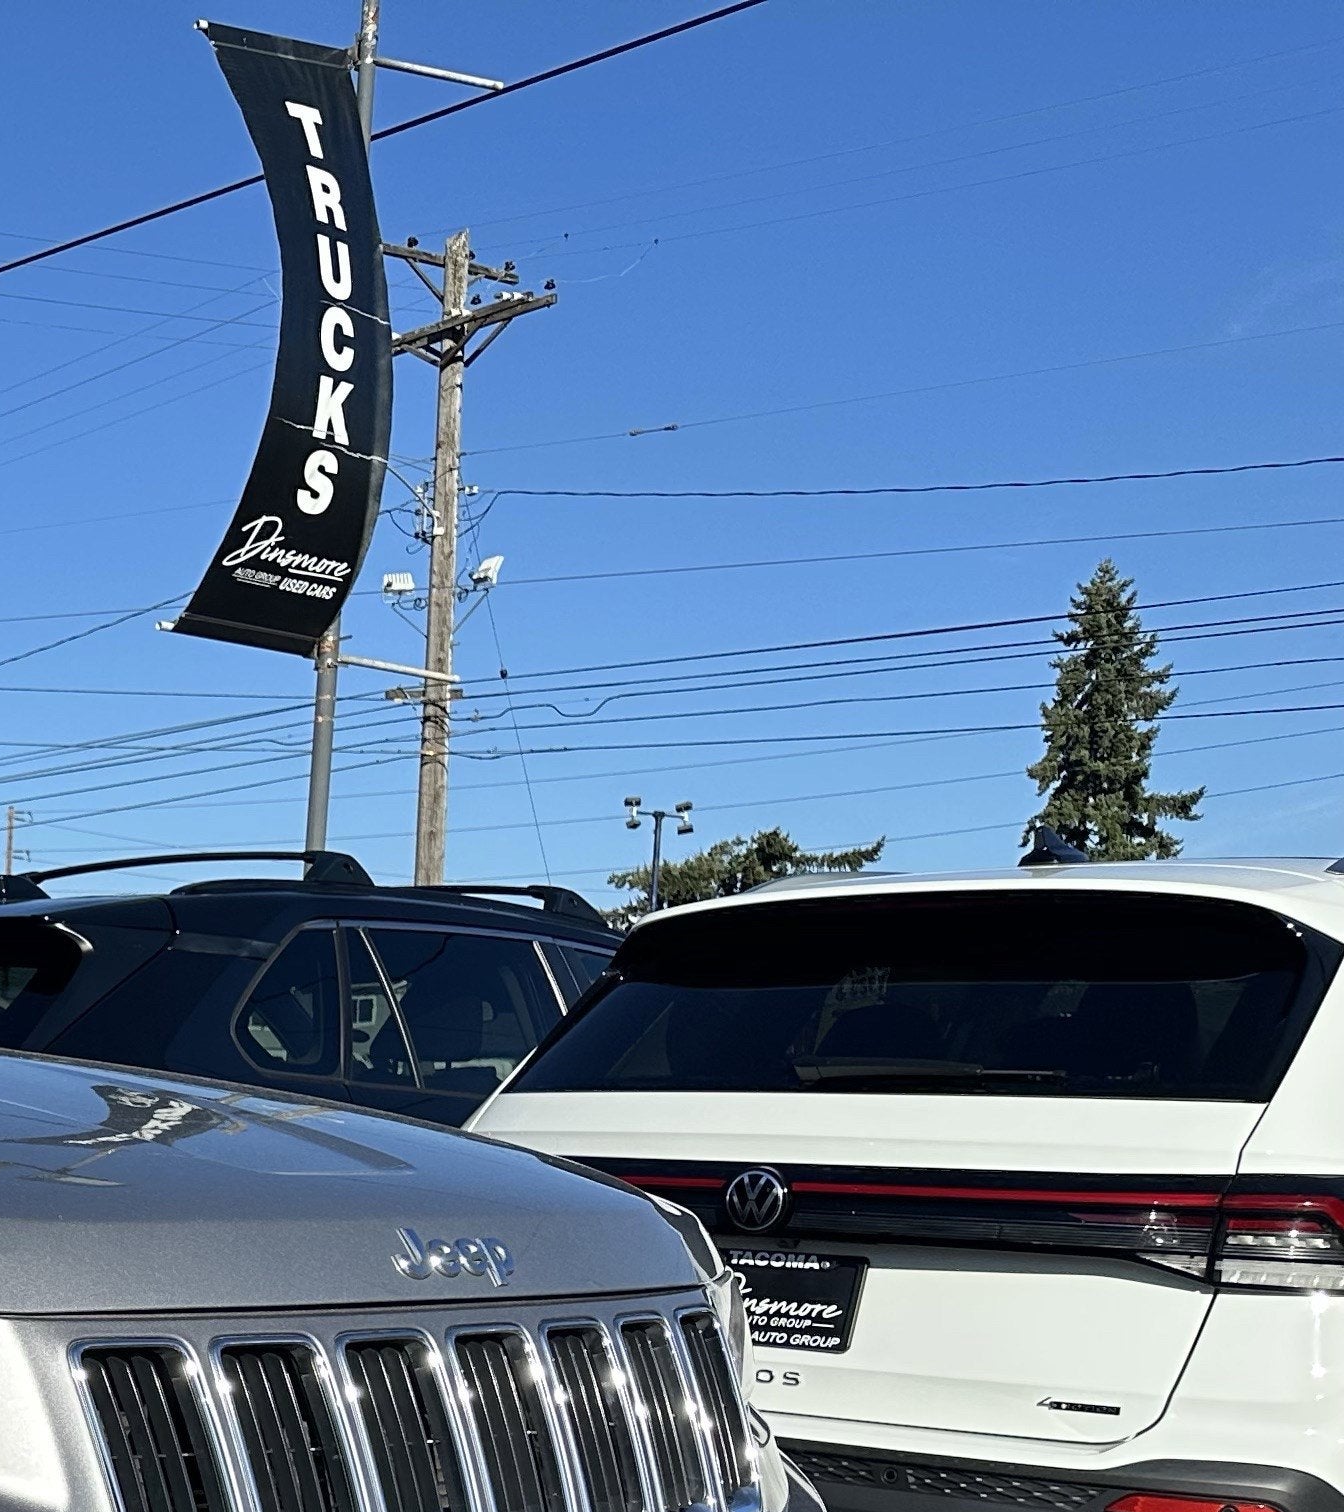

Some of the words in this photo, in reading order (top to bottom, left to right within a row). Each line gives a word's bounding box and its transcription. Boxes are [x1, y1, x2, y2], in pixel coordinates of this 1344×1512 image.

[284, 100, 355, 516] TRUCKS
[222, 515, 351, 577] Dinsmore
[279, 577, 309, 594] USED
[306, 583, 337, 600] CARS
[391, 1225, 515, 1288] Jeep
[729, 1250, 820, 1270] TACOMA
[733, 1271, 843, 1319] nsmore
[769, 1316, 812, 1329] GROUP
[751, 1331, 788, 1344] AUTO
[789, 1334, 841, 1348] GROUP
[755, 1369, 801, 1387] OS
